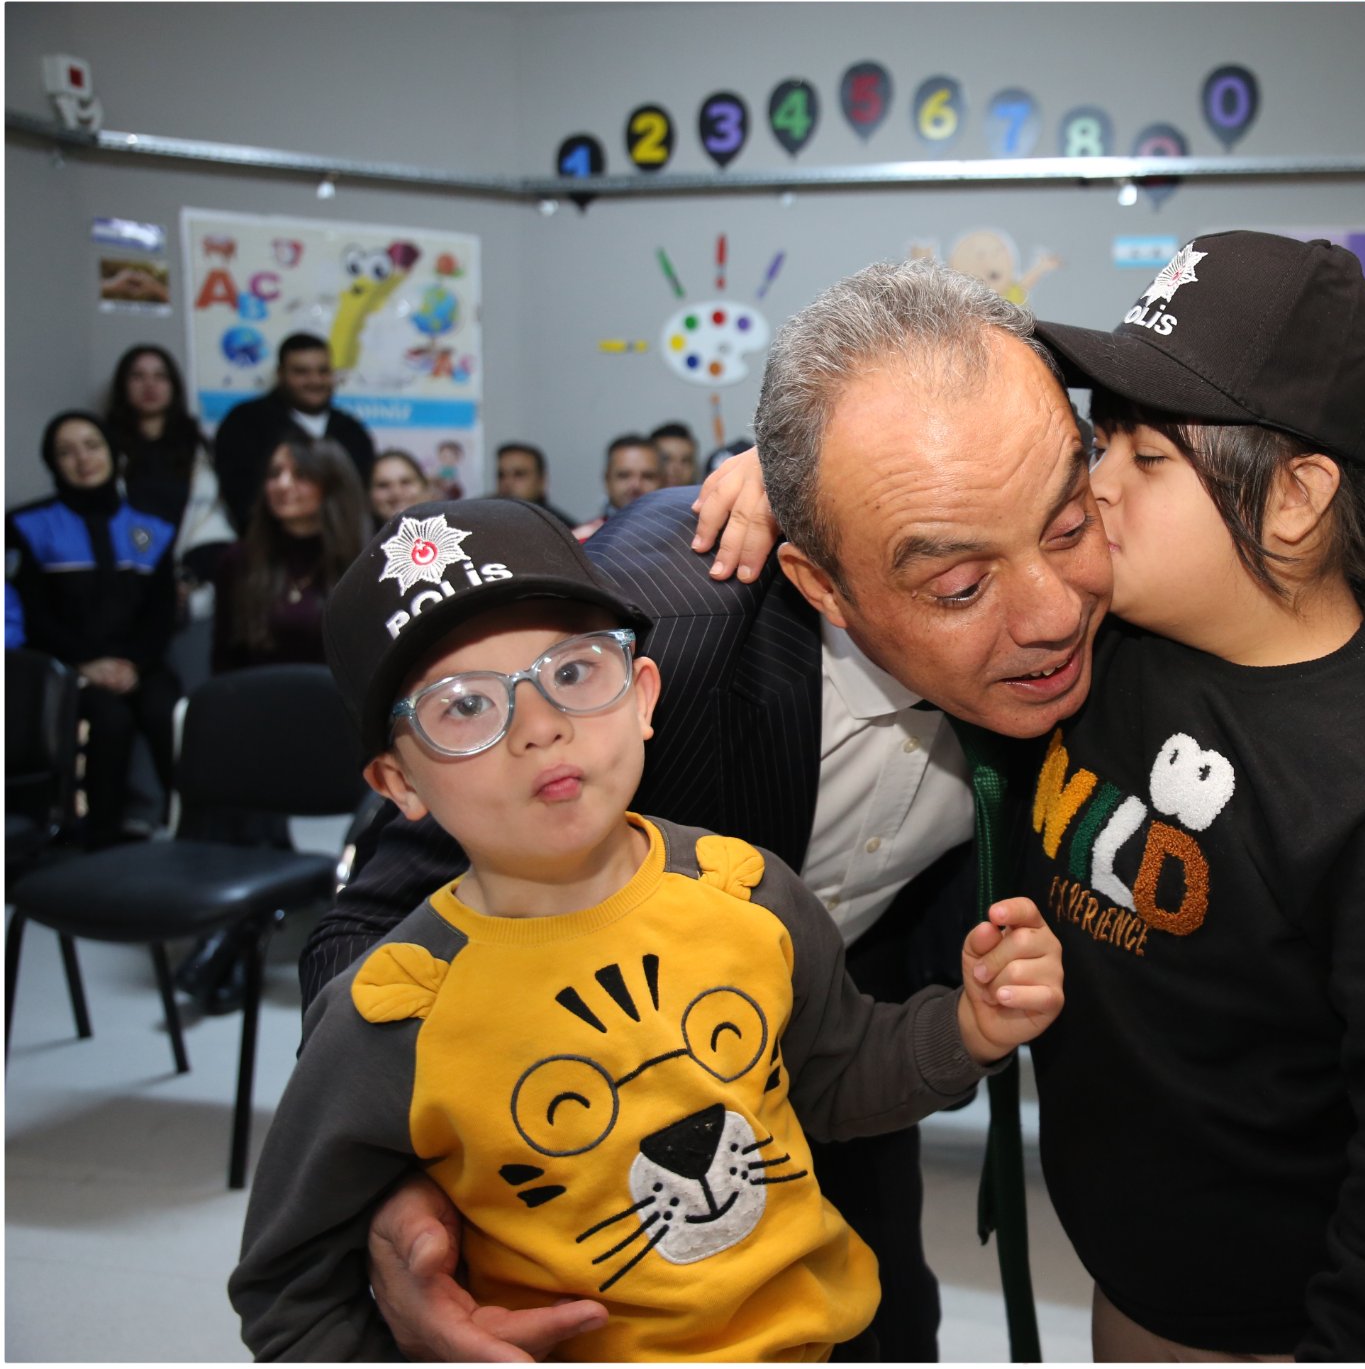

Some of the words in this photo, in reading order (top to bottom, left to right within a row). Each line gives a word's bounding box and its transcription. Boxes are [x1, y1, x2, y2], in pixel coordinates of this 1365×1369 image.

[631, 113, 668, 164] 2
[705, 102, 743, 153] 3
[772, 88, 812, 140] 4
[850, 74, 883, 124] 5
[919, 89, 958, 140] 6
[992, 101, 1031, 153] 7
[1211, 76, 1250, 128] 0
[1123, 304, 1178, 336] OLİS
